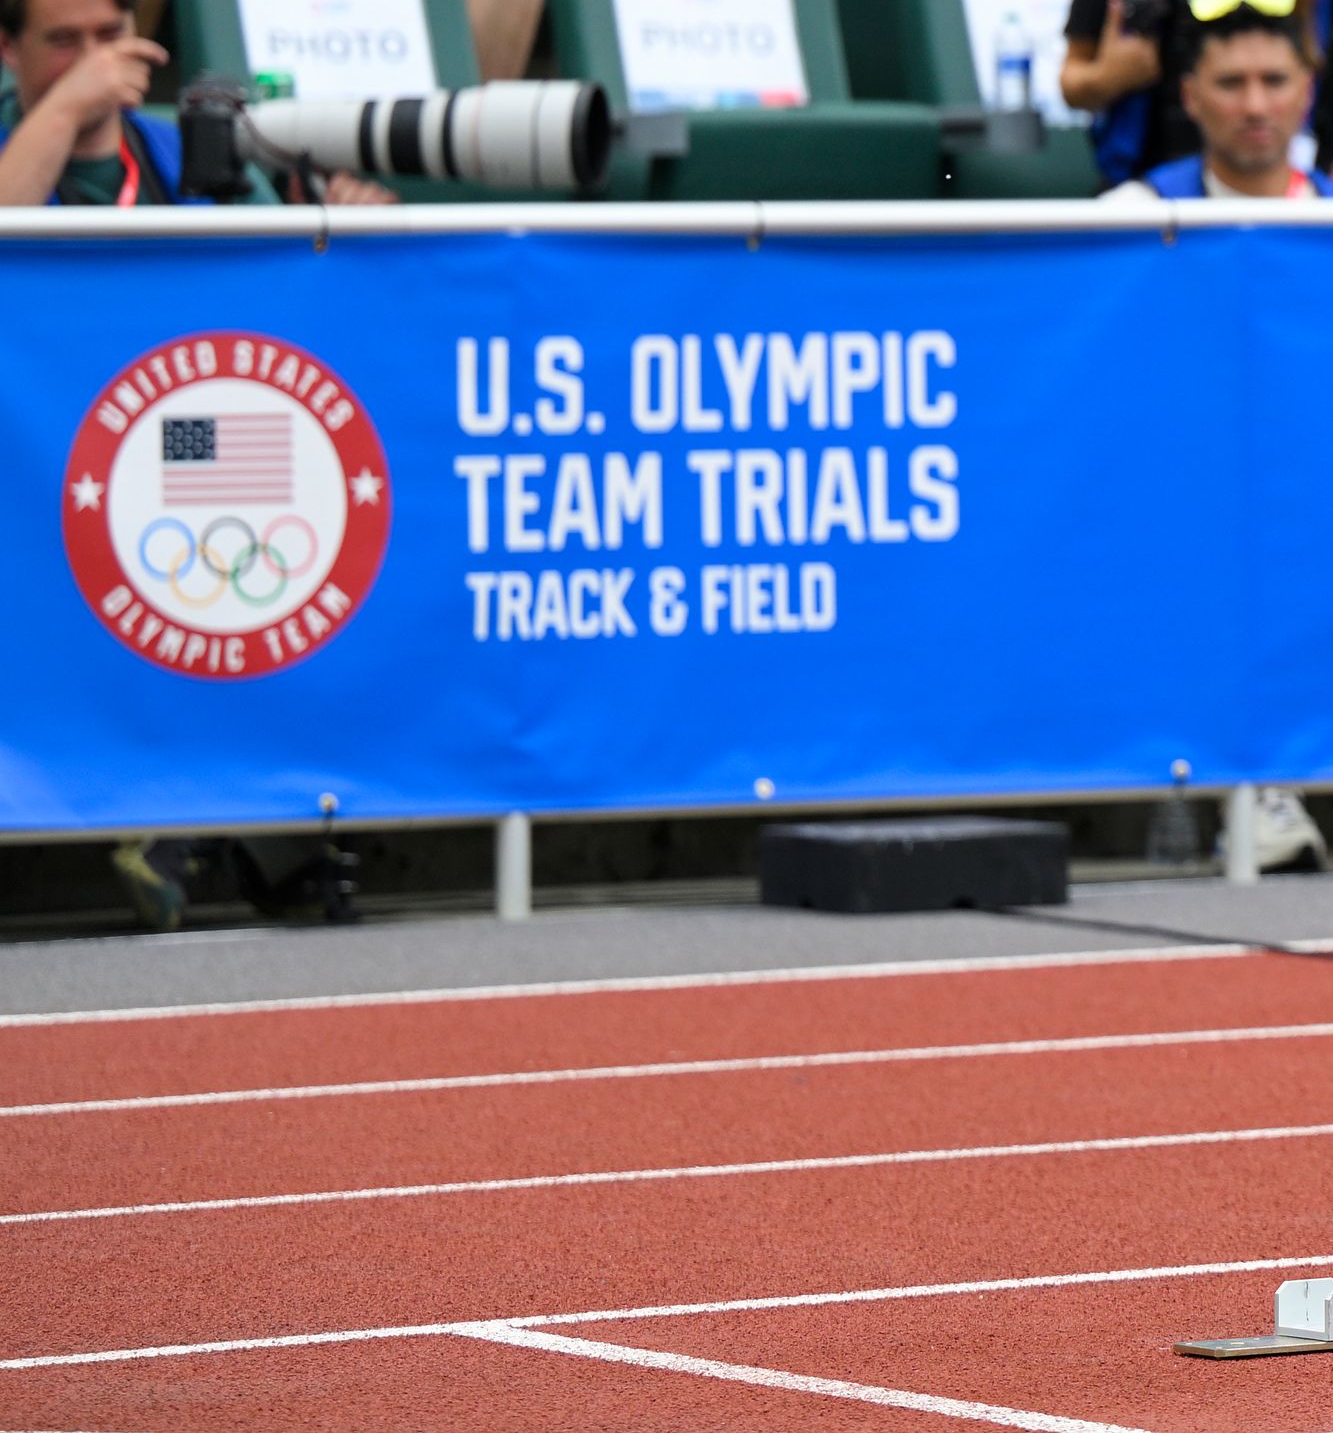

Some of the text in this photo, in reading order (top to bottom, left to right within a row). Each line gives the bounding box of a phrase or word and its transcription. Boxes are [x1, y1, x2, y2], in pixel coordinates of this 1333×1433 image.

[267, 27, 408, 65] PHOTO
[640, 18, 776, 60] PHOTO
[97, 340, 355, 434] UNITED STATES
[457, 330, 957, 436] U.S. OLYMPIC
[453, 445, 960, 554] TEAM TRIALS
[101, 582, 352, 673] OLYMPIC TEAM
[465, 561, 838, 641] TRACK & FIELD
